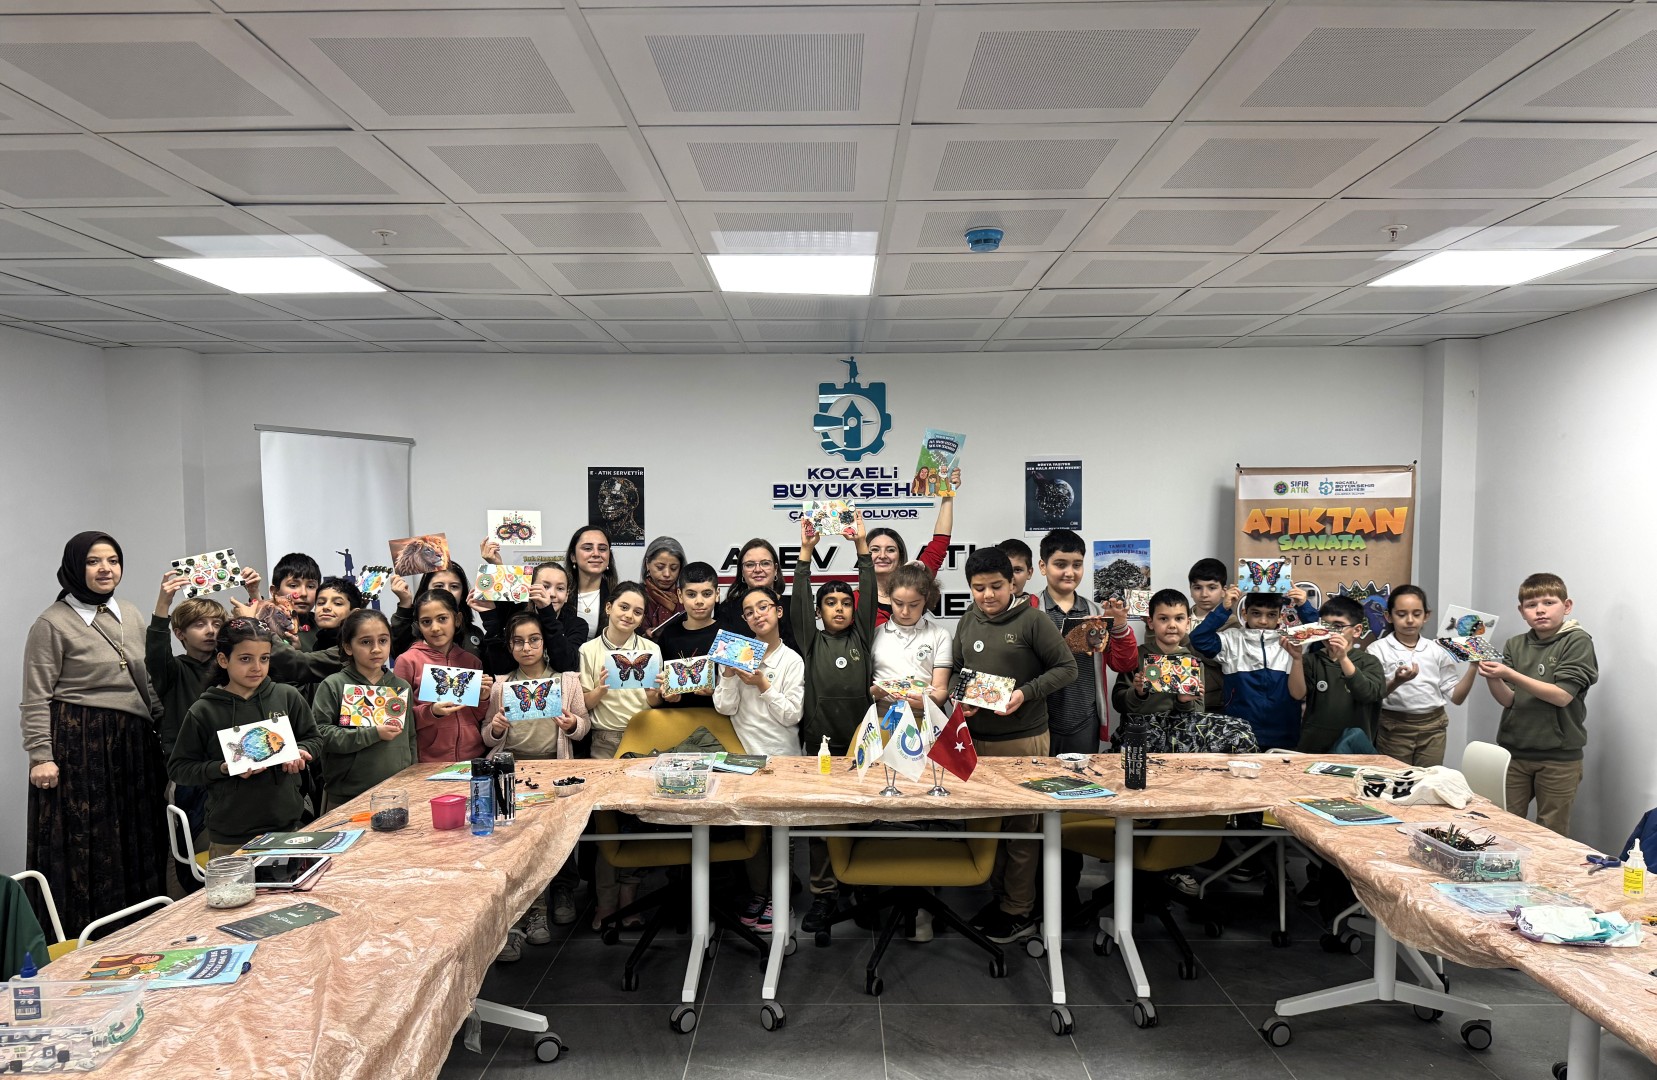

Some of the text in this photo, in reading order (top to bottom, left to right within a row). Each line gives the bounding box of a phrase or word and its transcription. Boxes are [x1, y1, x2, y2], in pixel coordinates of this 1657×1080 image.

[773, 482, 924, 500] BÜYÜKŞEH
[862, 509, 918, 518] OLUYOR
[1242, 506, 1408, 536] ATIKTAN
[1277, 534, 1367, 552] SANATA
[721, 546, 838, 570] AEV
